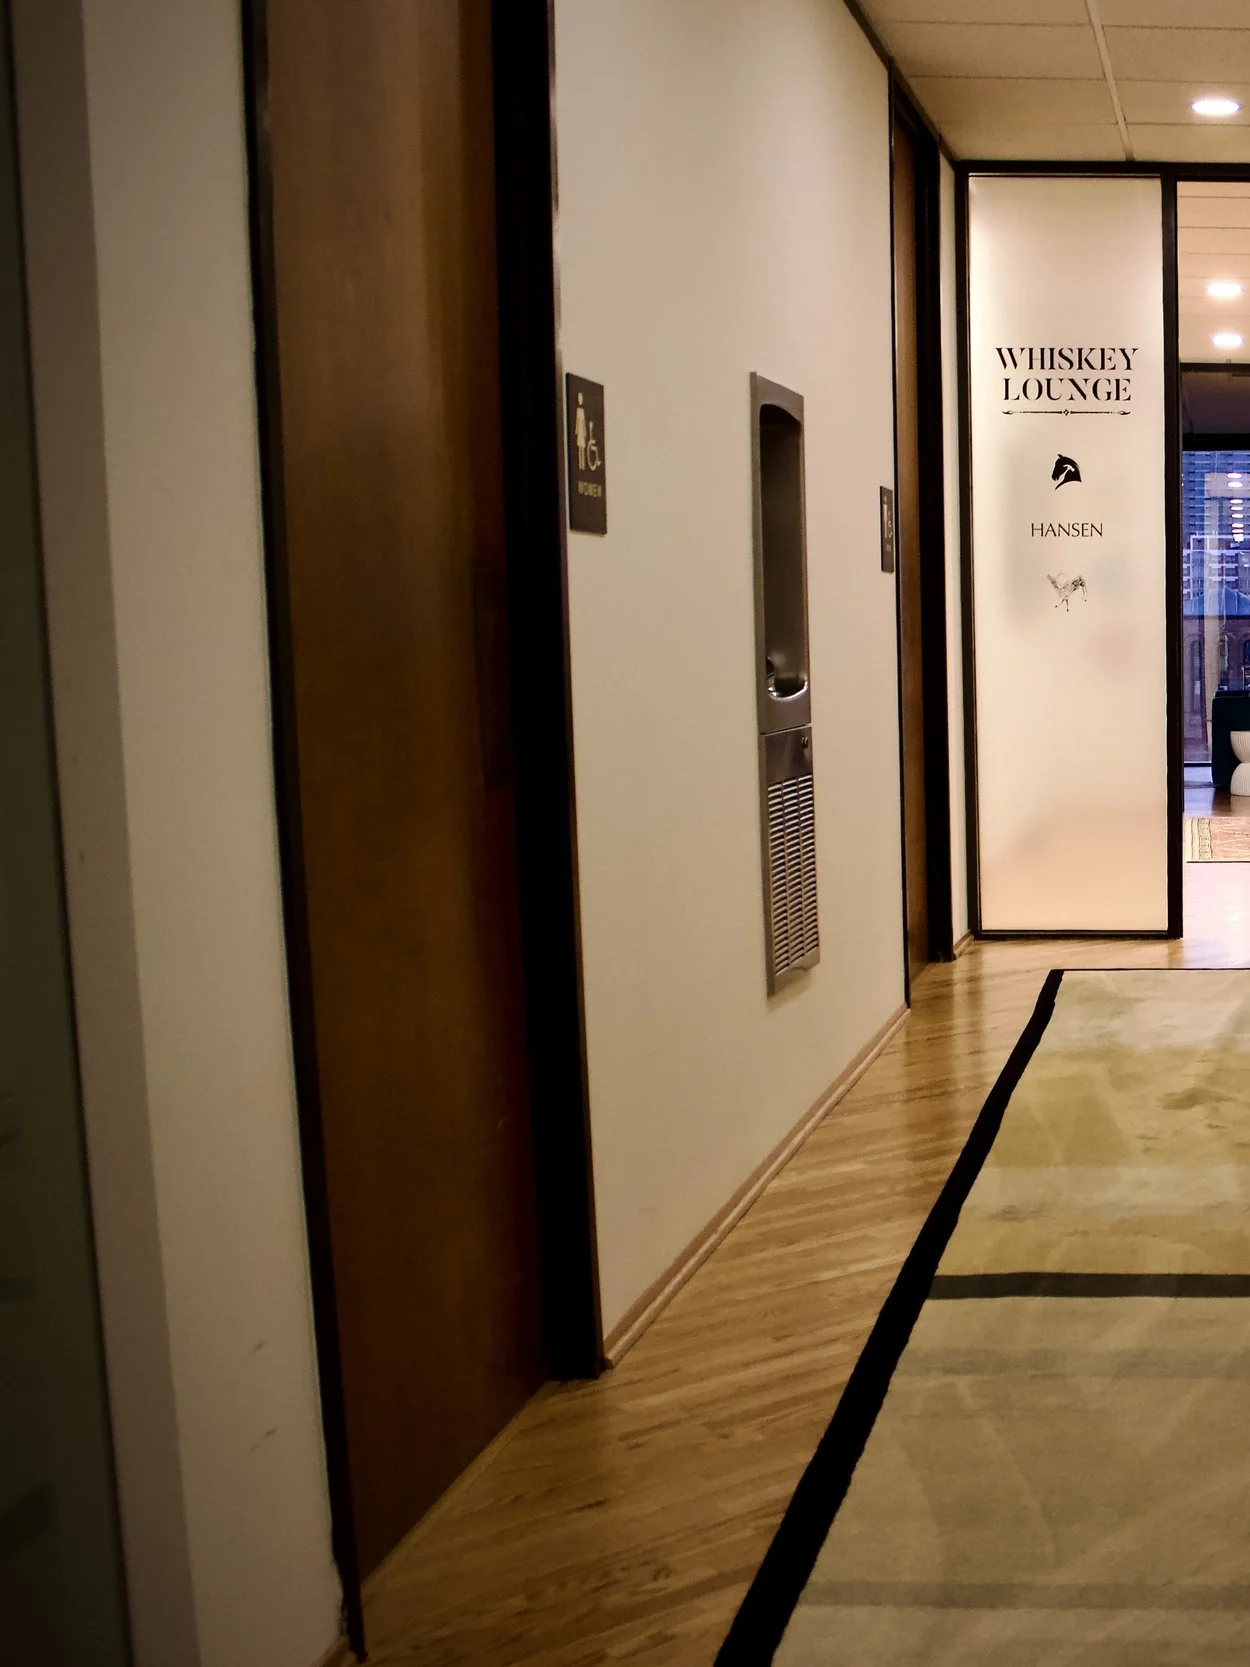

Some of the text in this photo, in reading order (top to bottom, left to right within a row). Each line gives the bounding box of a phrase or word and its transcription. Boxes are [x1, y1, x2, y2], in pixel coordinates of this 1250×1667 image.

[995, 347, 1138, 371] WHISKEY
[1003, 377, 1132, 402] LOUNGE
[577, 480, 602, 498] WOMEN
[1031, 522, 1103, 538] HANSEN
